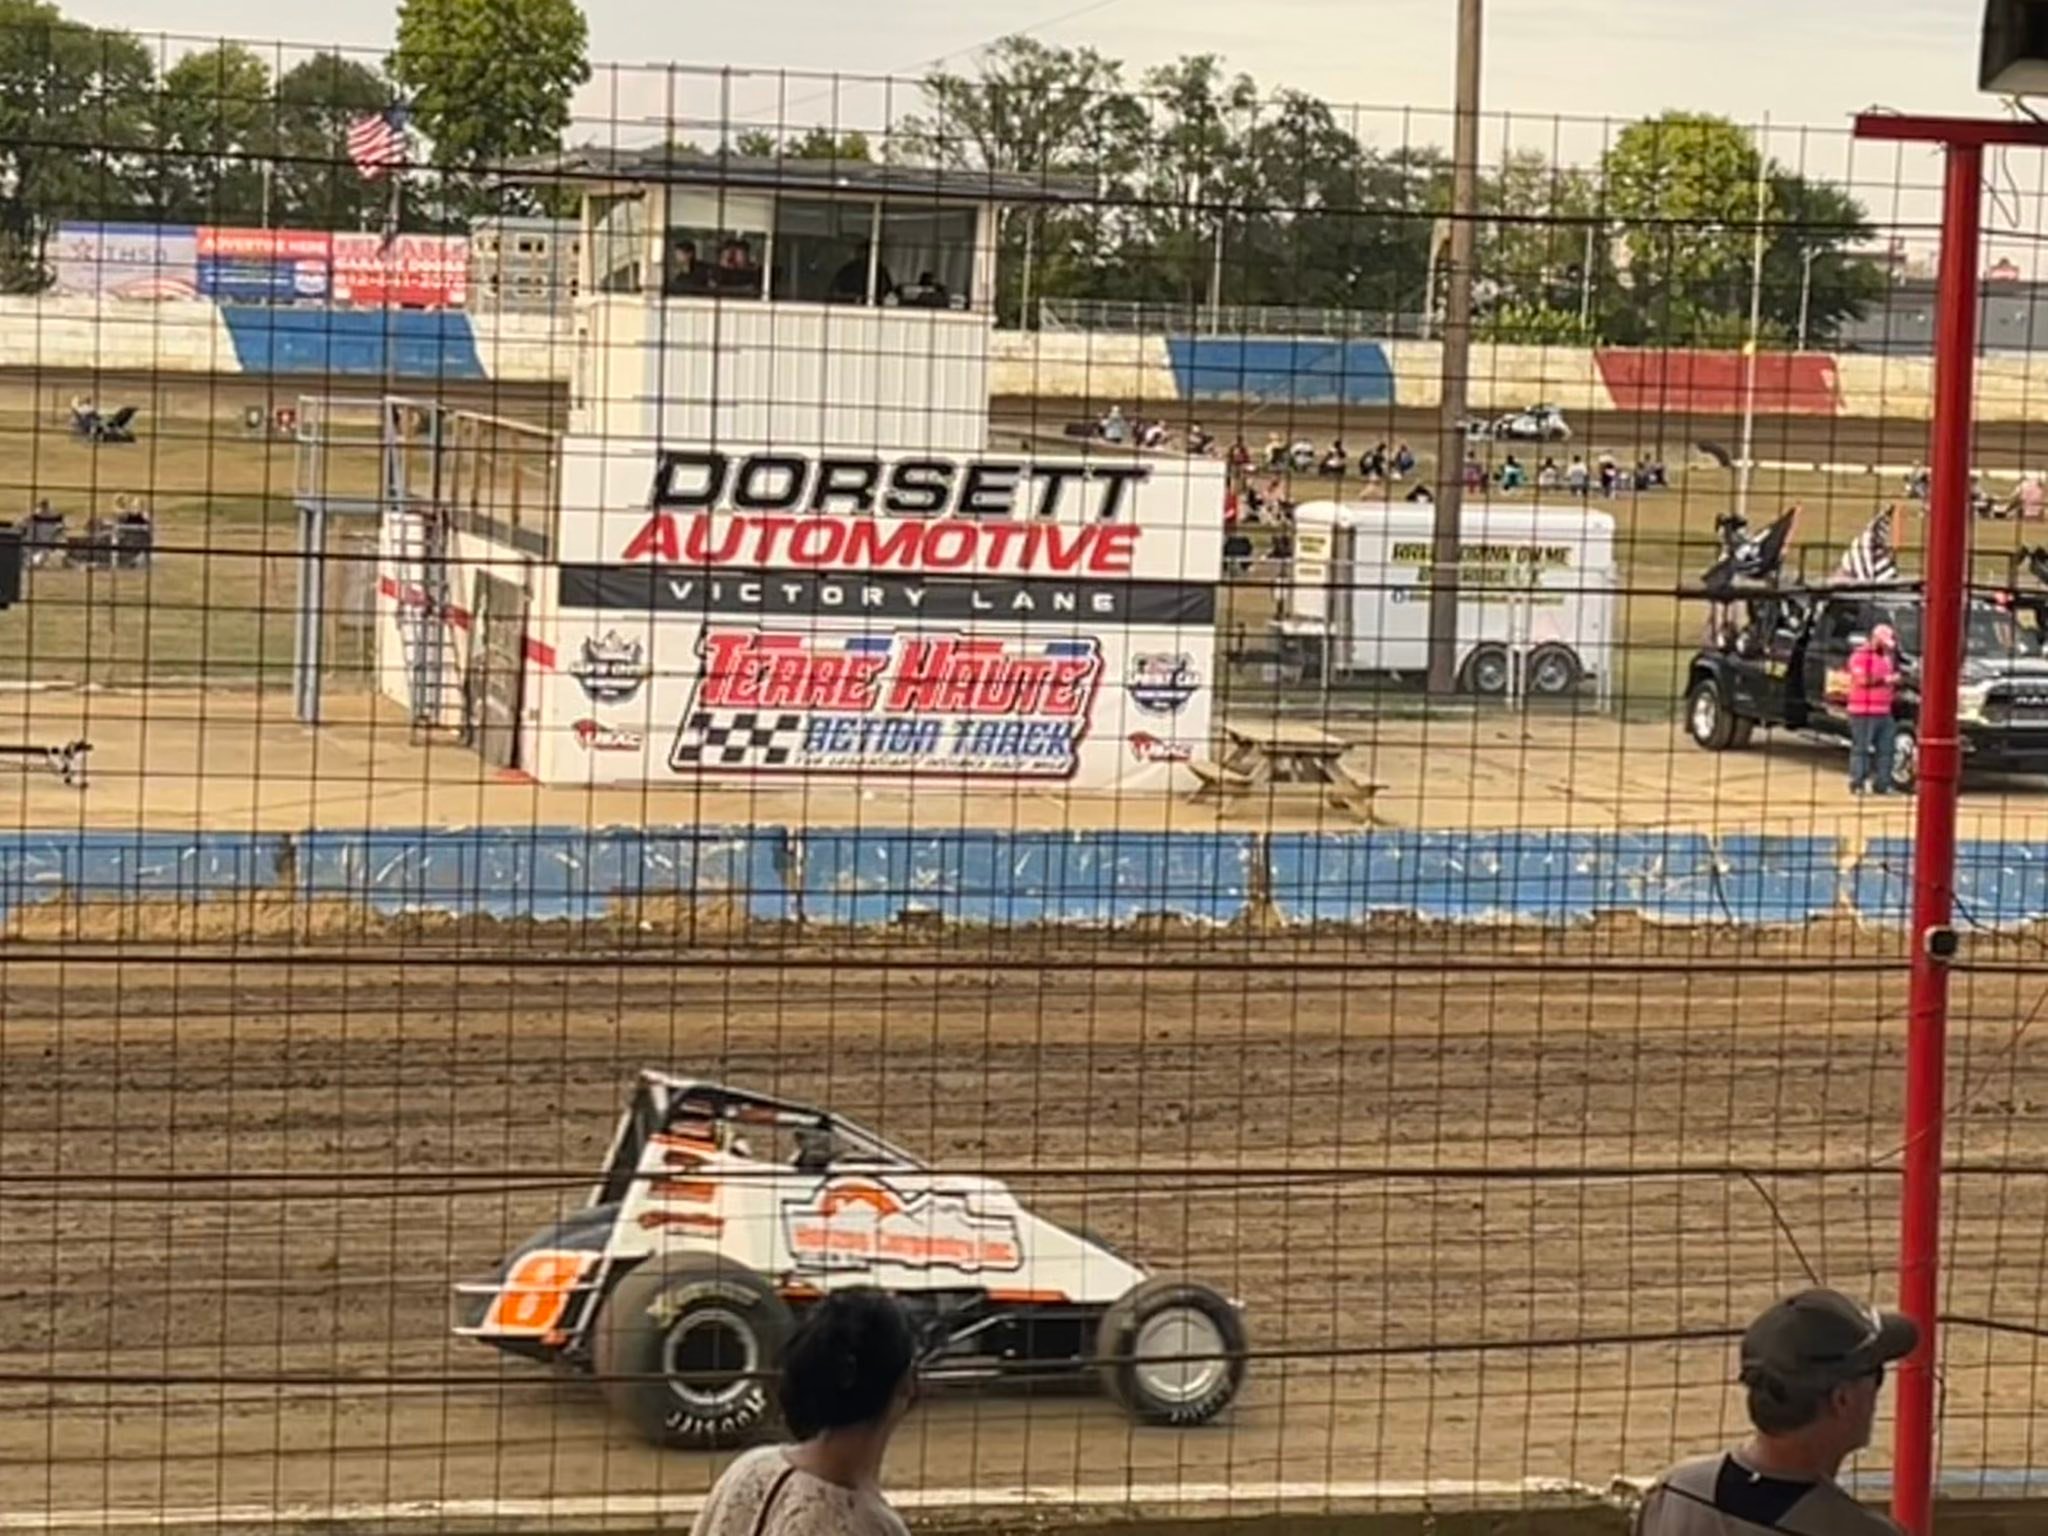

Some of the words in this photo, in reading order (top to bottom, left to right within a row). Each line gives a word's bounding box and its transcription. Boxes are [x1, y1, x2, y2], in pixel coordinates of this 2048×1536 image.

[652, 451, 1150, 521] DORSETT
[621, 512, 1142, 573] AUTOMOTIVE
[669, 579, 926, 608] VICTORY
[970, 589, 1116, 613] LANE
[801, 715, 941, 756] ACTION
[953, 718, 1076, 759] TRACK
